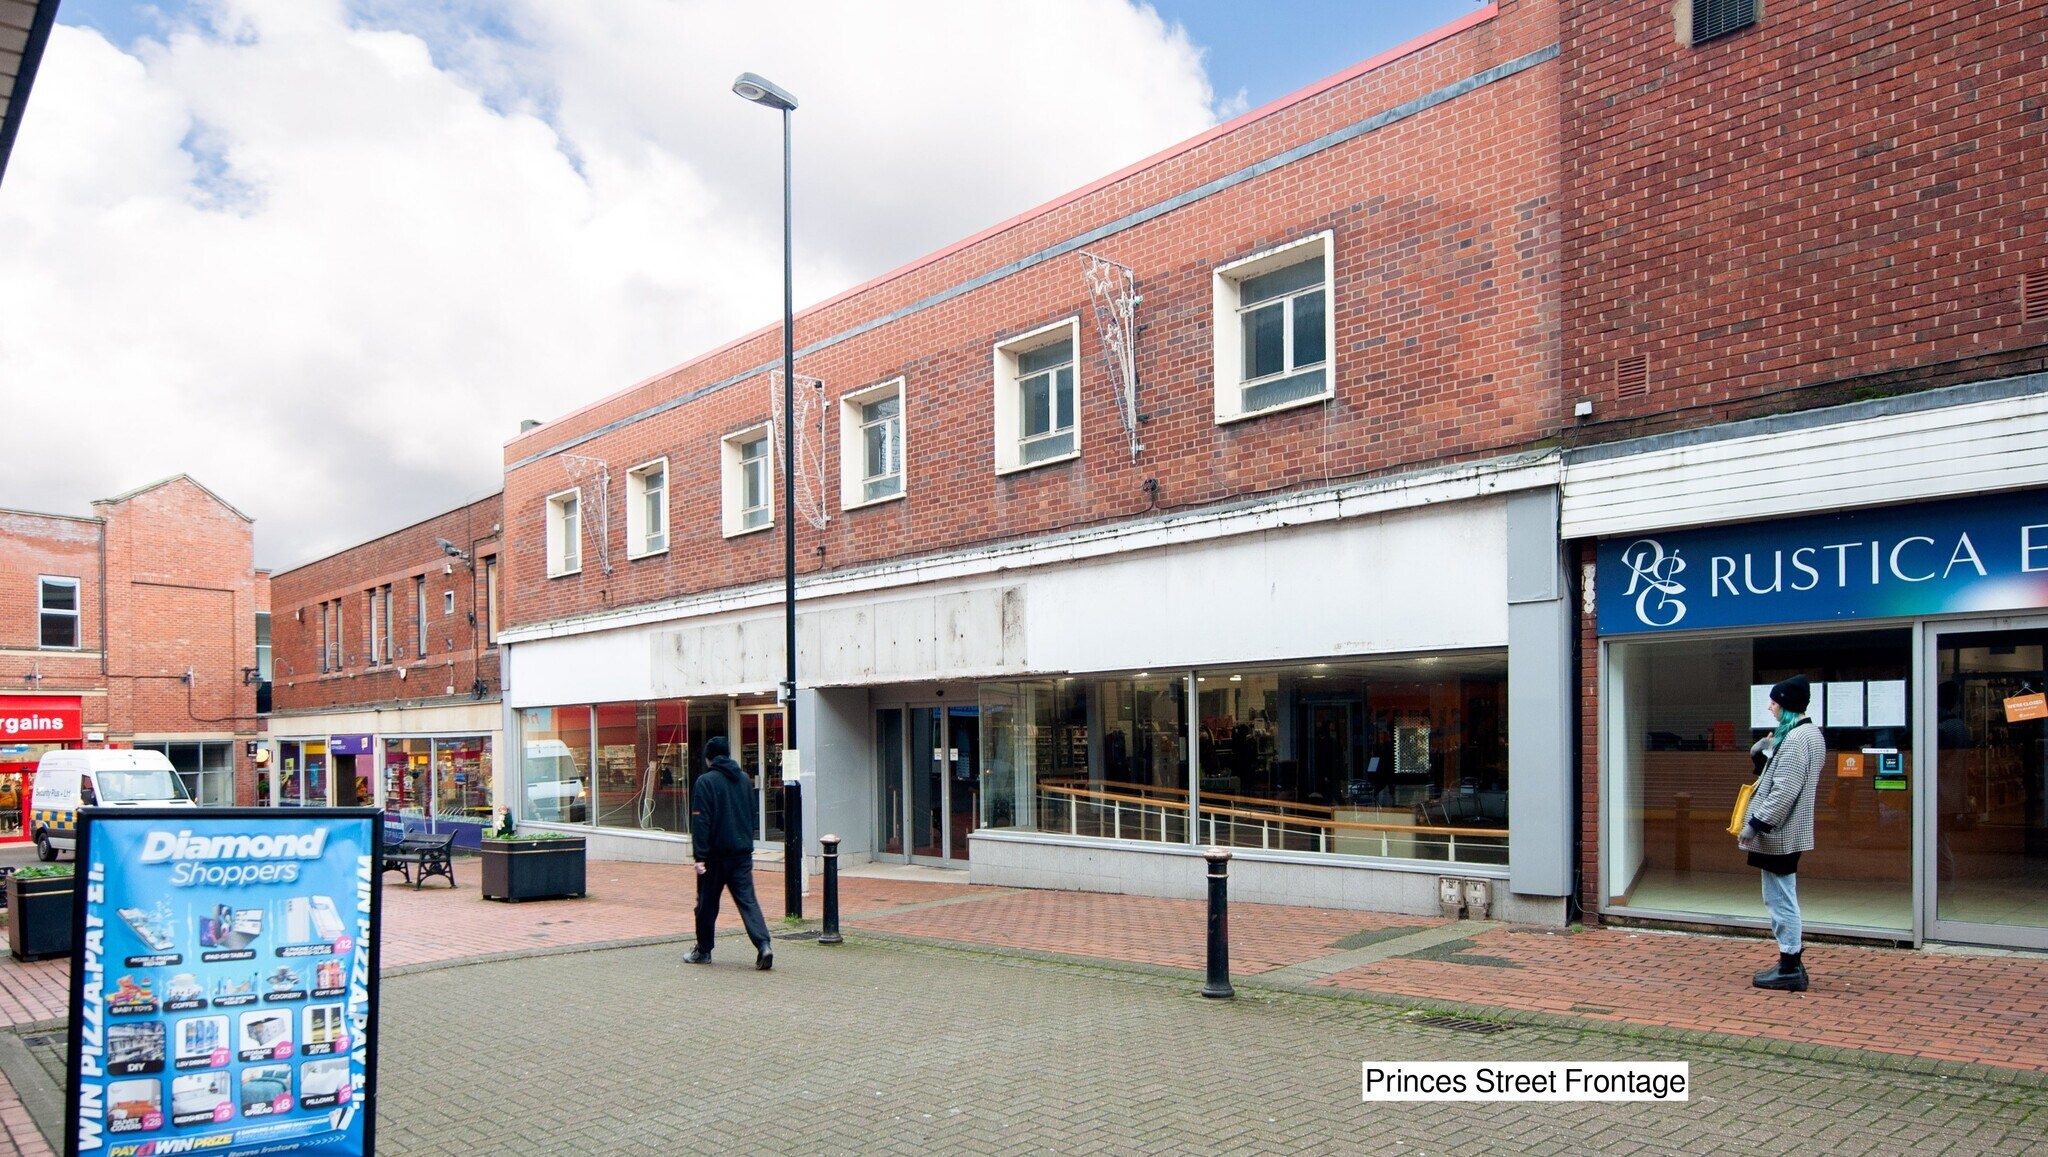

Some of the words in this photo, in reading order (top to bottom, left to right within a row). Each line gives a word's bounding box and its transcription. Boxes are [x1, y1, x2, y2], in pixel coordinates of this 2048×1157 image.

[1711, 531, 1988, 597] RUSTICA
[140, 827, 329, 863] Diamond
[171, 861, 298, 886] Shoppers
[357, 855, 372, 914] WIN
[269, 992, 302, 1000] COOKERY
[171, 1001, 199, 1009] COFFEE
[127, 1063, 146, 1072] DIY
[277, 1098, 291, 1110] £8
[306, 1096, 335, 1106] PILLOWS
[78, 1083, 103, 1151] WIN
[174, 1113, 214, 1124] BEDSHEETS
[110, 1123, 142, 1132] COVERS
[110, 1145, 139, 1157] PAY
[155, 1137, 195, 1155] WIN
[193, 1133, 234, 1149] PRIZE
